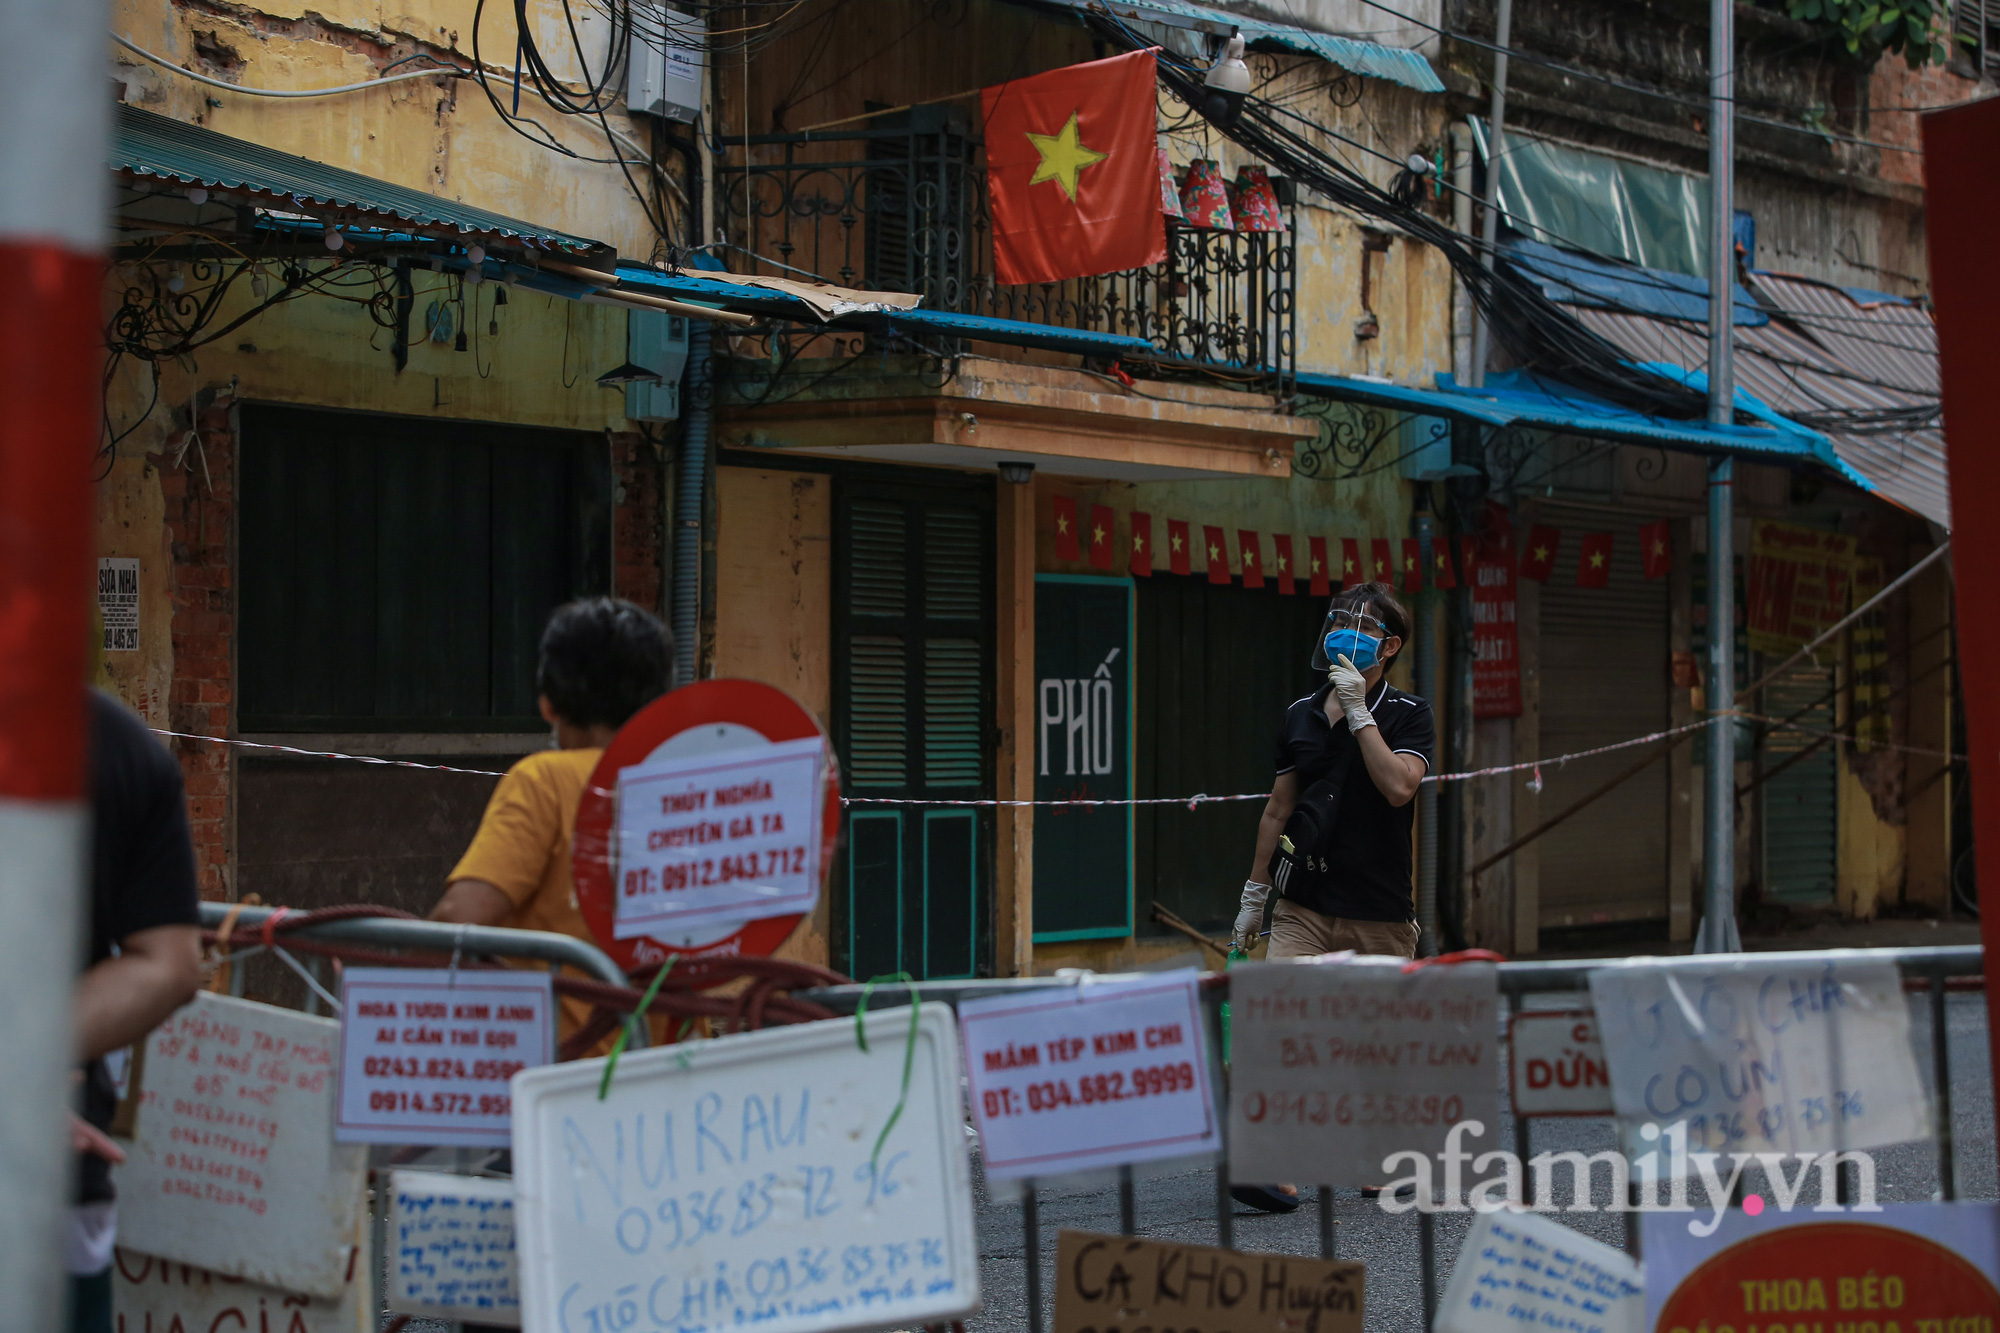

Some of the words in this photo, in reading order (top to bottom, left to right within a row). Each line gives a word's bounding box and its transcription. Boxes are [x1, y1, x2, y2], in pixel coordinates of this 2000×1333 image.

[98, 558, 117, 594] SỬA
[118, 564, 138, 594] NHÀ
[1040, 647, 1120, 776] PHỐ
[648, 819, 722, 851] CHUYÊN
[762, 813, 784, 833] TA
[358, 1003, 398, 1017] HOA
[496, 1005, 535, 1021] ANH
[376, 1027, 396, 1043] AI
[1093, 1029, 1137, 1056] KIM
[1144, 1023, 1184, 1048] CHI
[369, 1090, 511, 1116] 0914.572.95
[983, 1087, 1022, 1119] ĐT:
[1027, 1062, 1195, 1113] 034.682.9999
[1153, 1247, 1247, 1310] KHO
[1738, 1279, 1827, 1312] THOA
[1837, 1270, 1905, 1310] BÉO
